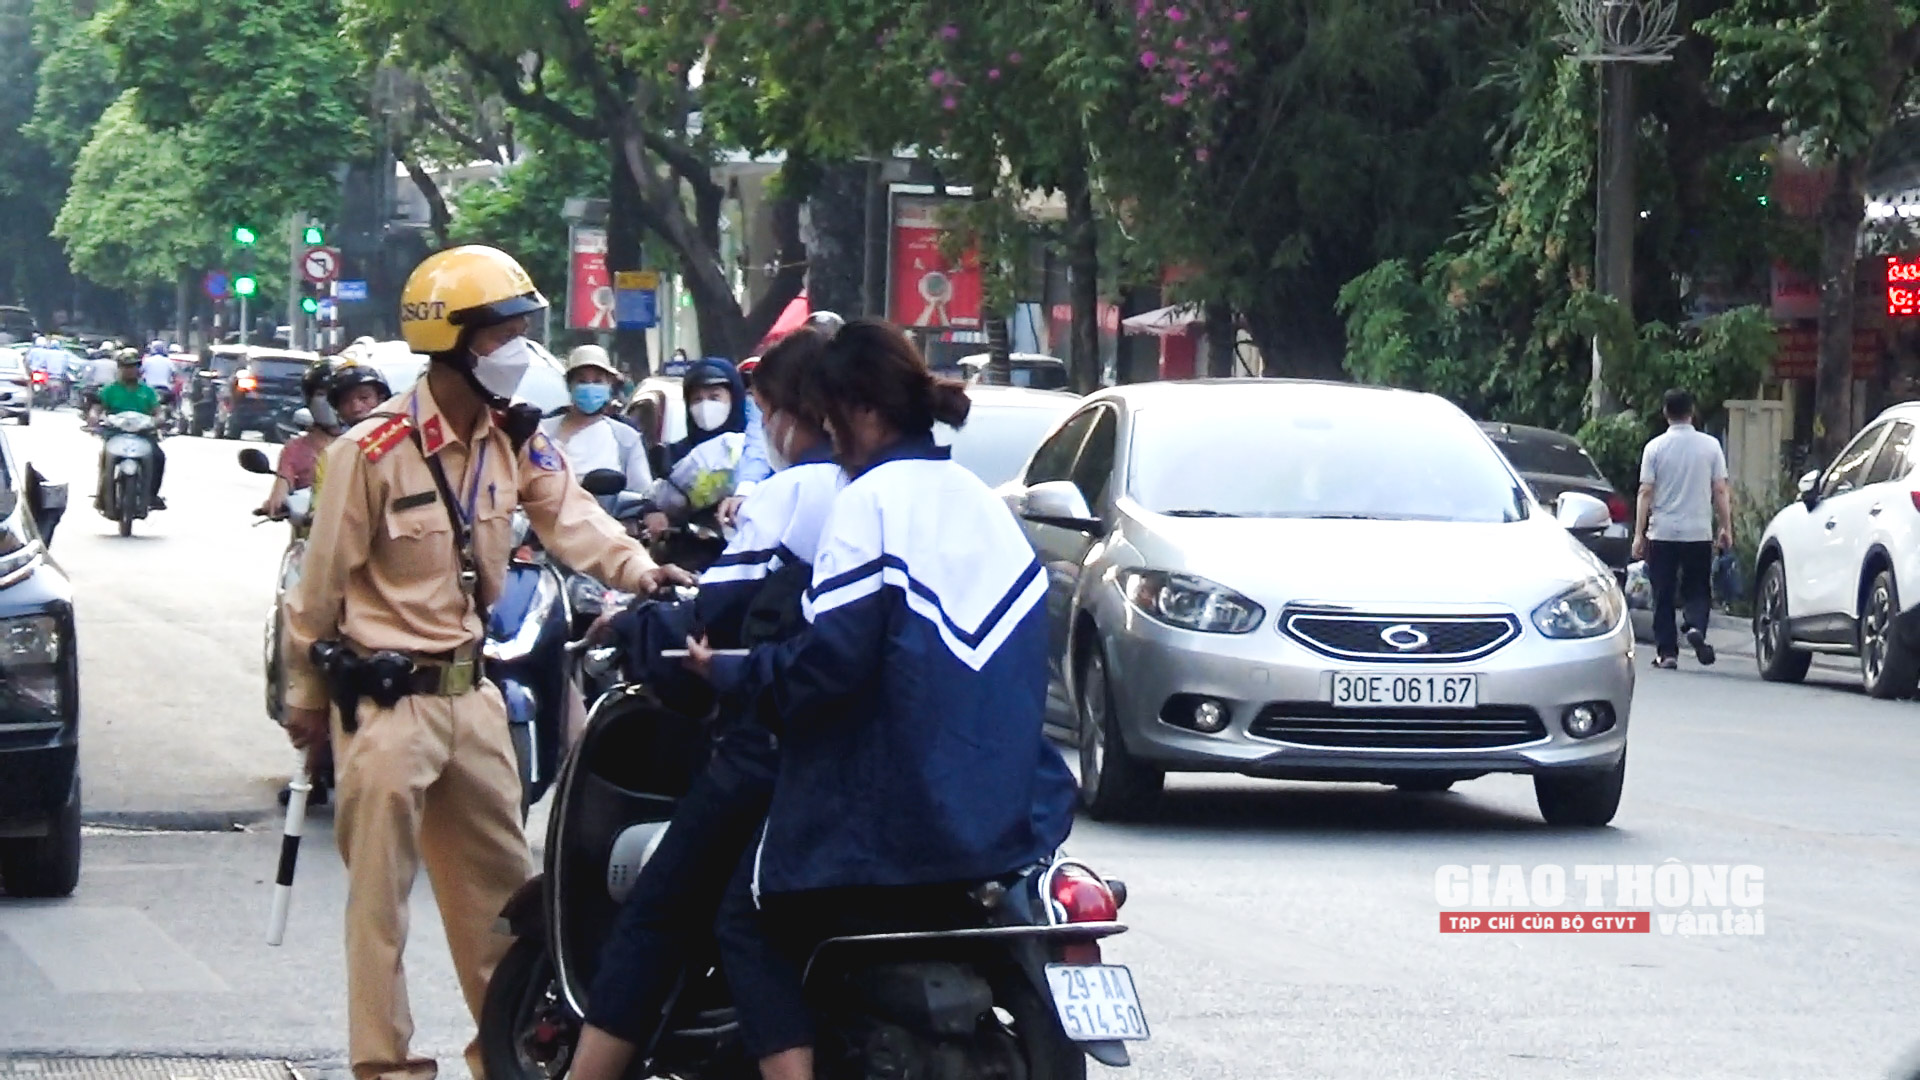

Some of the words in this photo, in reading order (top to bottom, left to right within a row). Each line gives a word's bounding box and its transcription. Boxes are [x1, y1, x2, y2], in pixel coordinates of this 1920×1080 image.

[1338, 677, 1472, 703] 30E-061.67
[1061, 969, 1126, 999] 29-AA
[1064, 1004, 1142, 1034] 514.50
